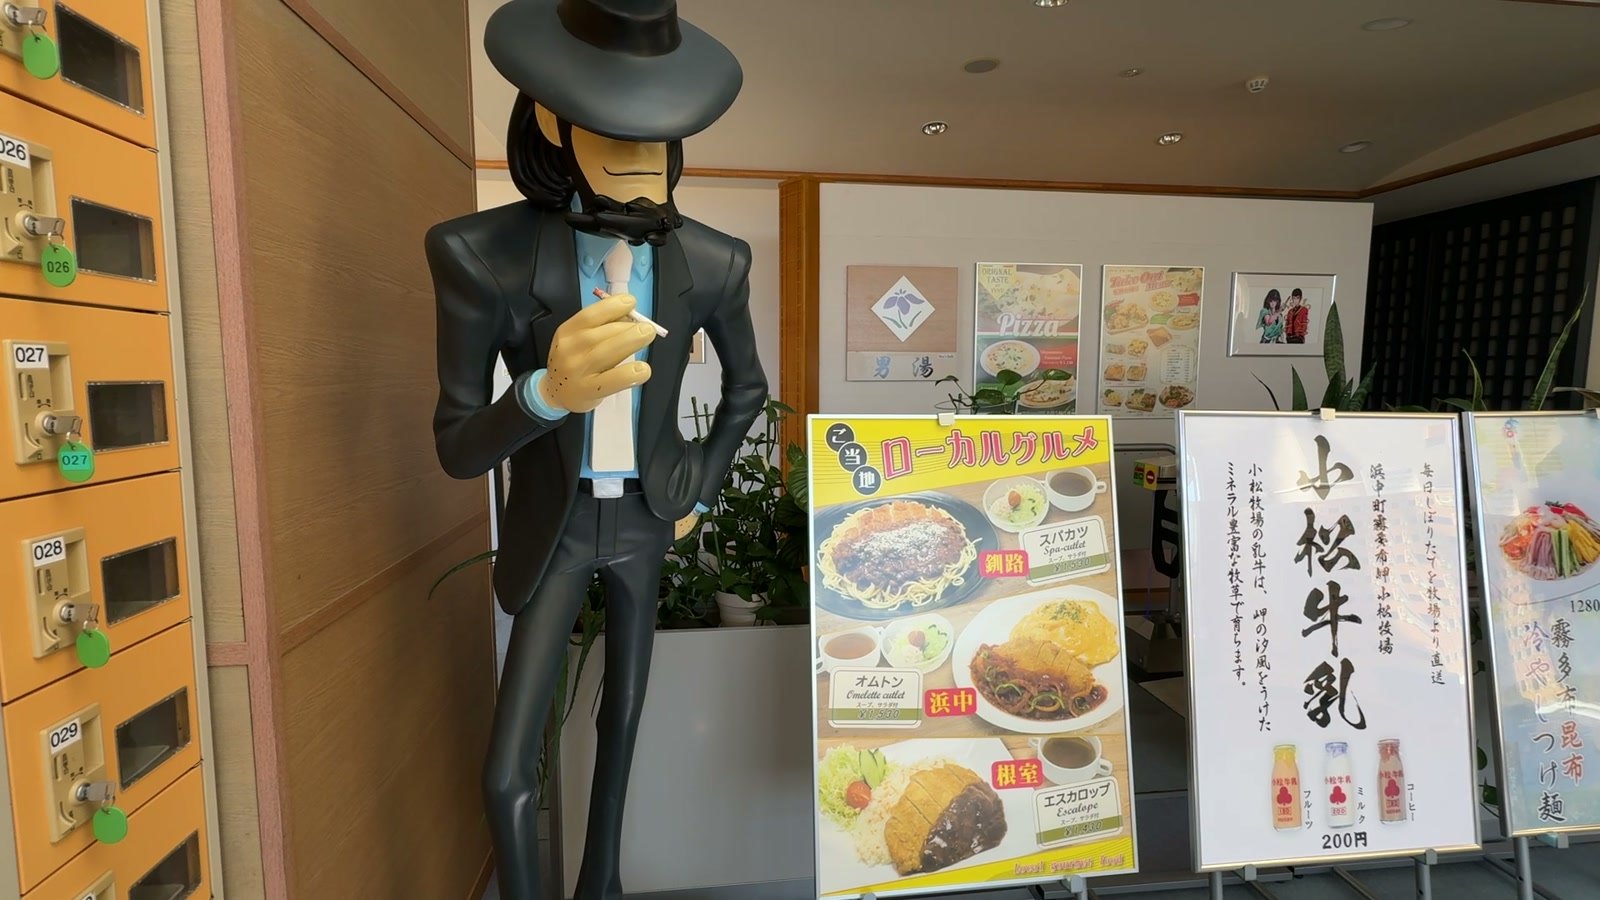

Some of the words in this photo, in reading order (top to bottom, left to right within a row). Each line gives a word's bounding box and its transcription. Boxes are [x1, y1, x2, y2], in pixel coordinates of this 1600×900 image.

[47, 261, 70, 273] 026
[997, 312, 1060, 337] Pizza
[15, 347, 44, 362] 027
[62, 455, 88, 466] 027
[881, 426, 1100, 481] ローカルグルメ
[1040, 526, 1088, 547] スパカツ
[34, 540, 63, 560] 028
[1043, 540, 1086, 557] Spa-cutlet
[984, 553, 1026, 575] 釧路
[1294, 434, 1367, 731] 小松牛乳
[1570, 598, 1600, 613] 1280
[855, 675, 904, 688] オムトン
[846, 689, 880, 700] Omelette
[882, 689, 905, 700] cutlet
[929, 690, 973, 714] 浜中
[1550, 618, 1585, 786] 霧多布昆布
[1523, 620, 1566, 823] 冷やしつけ麺
[51, 722, 78, 748] 029
[997, 762, 1039, 787] 根室
[1044, 782, 1111, 808] エスカロップ
[1357, 787, 1366, 825] ミルク
[1407, 783, 1416, 822] コーヒー
[1056, 802, 1099, 817] Escalope
[1303, 789, 1313, 830] フルーツ
[1321, 831, 1368, 850] 200円
